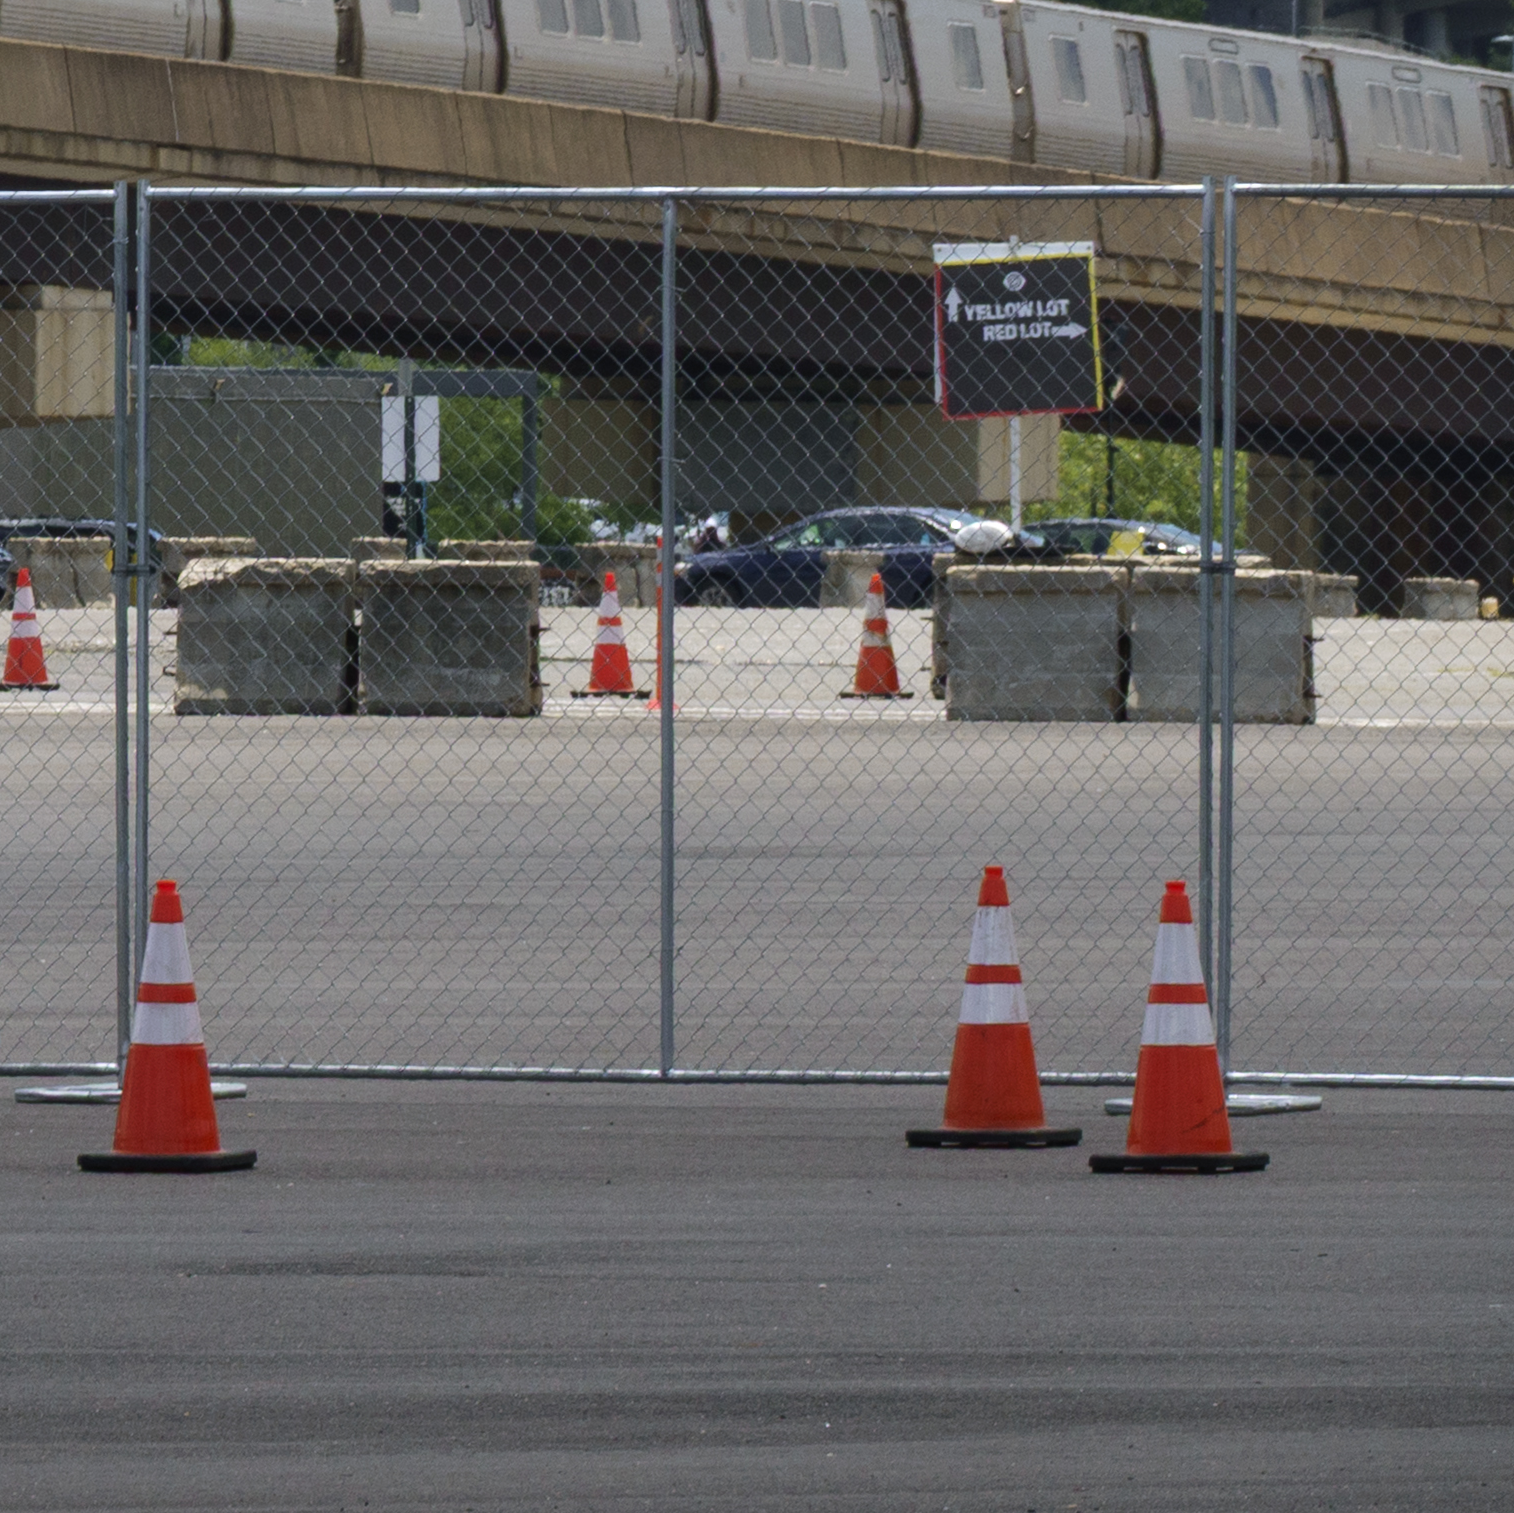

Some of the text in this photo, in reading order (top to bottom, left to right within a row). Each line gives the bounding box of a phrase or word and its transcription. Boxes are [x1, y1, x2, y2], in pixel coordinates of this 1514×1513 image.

[964, 299, 1070, 321] YELLOW LOT
[983, 322, 1052, 341] RED LOT
